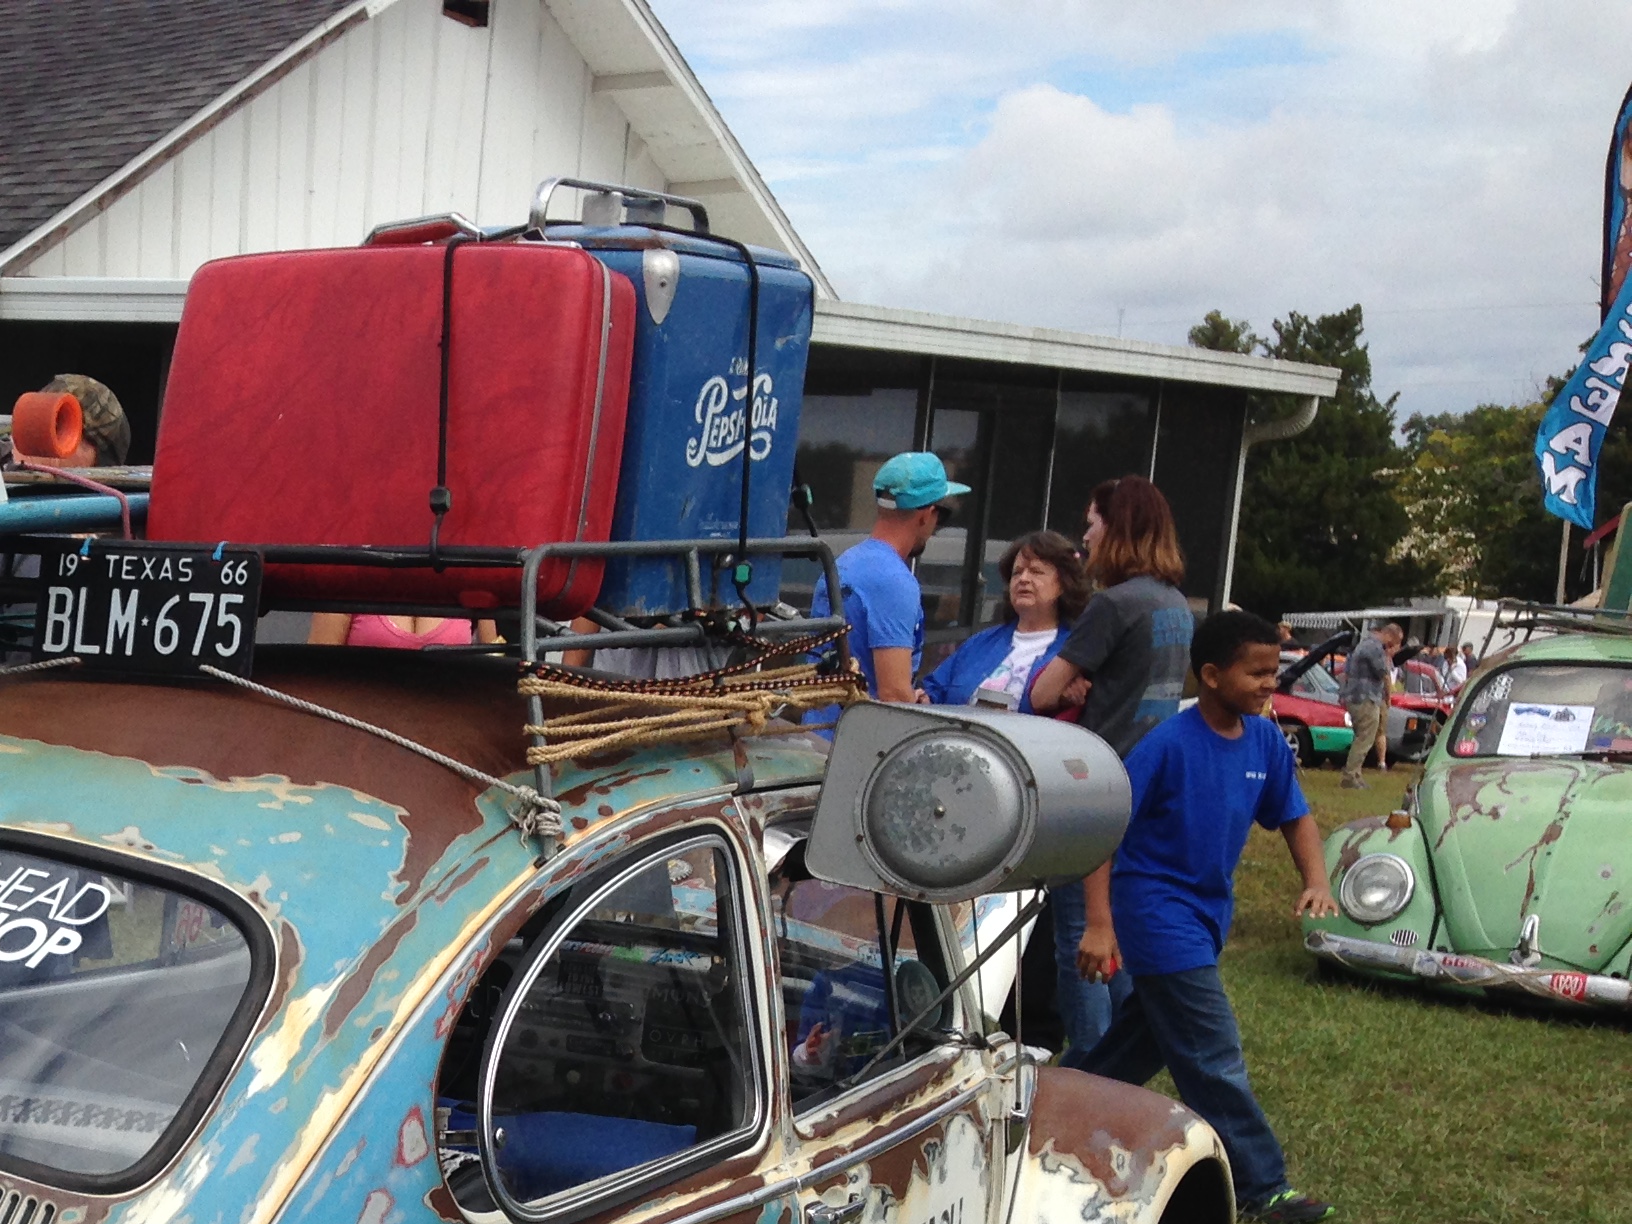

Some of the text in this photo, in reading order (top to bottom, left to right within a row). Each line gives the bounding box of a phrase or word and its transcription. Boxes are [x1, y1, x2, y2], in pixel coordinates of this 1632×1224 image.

[58, 553, 78, 577] 19
[105, 554, 194, 582] TEXAS
[220, 560, 249, 586] 66
